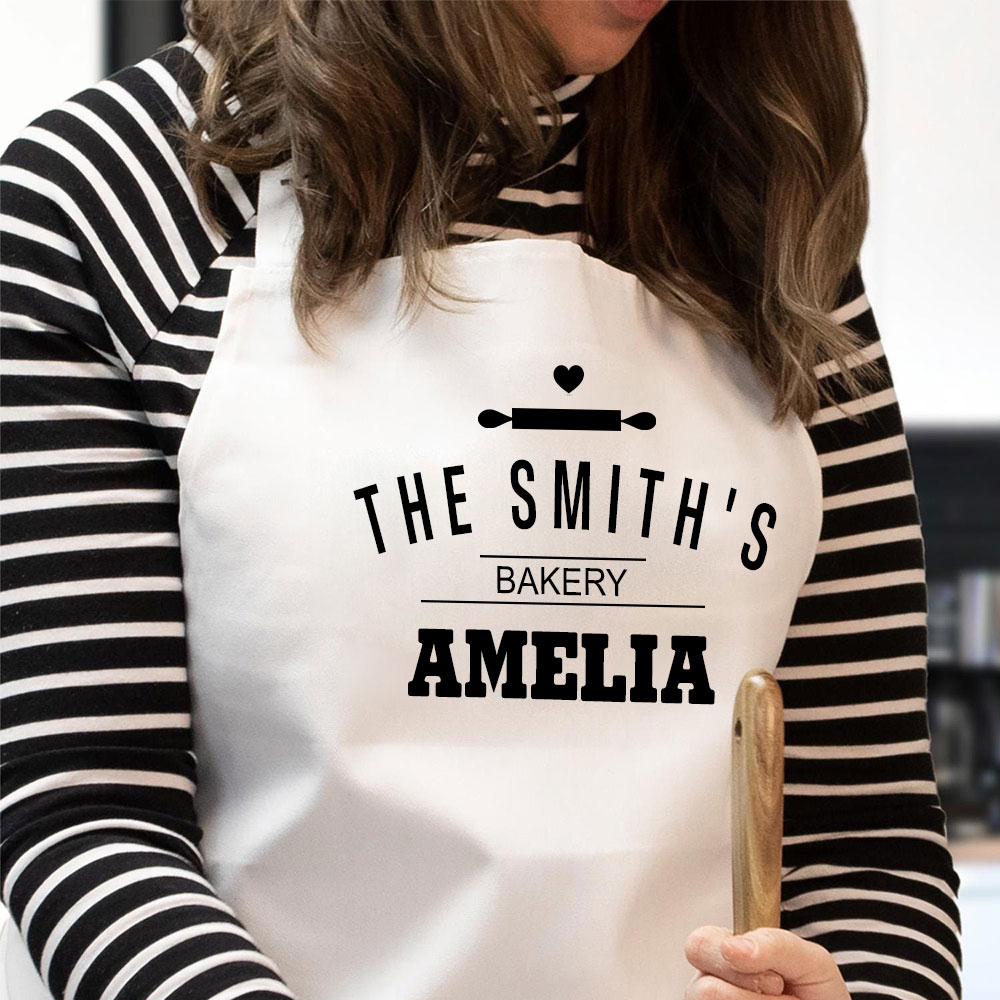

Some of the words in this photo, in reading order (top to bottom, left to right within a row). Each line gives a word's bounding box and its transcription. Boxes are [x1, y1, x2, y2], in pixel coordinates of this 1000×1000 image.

[353, 464, 473, 555] THE
[510, 459, 777, 571] SMITH'S
[496, 565, 628, 597] BAKERY
[407, 628, 716, 705] AMELIA
